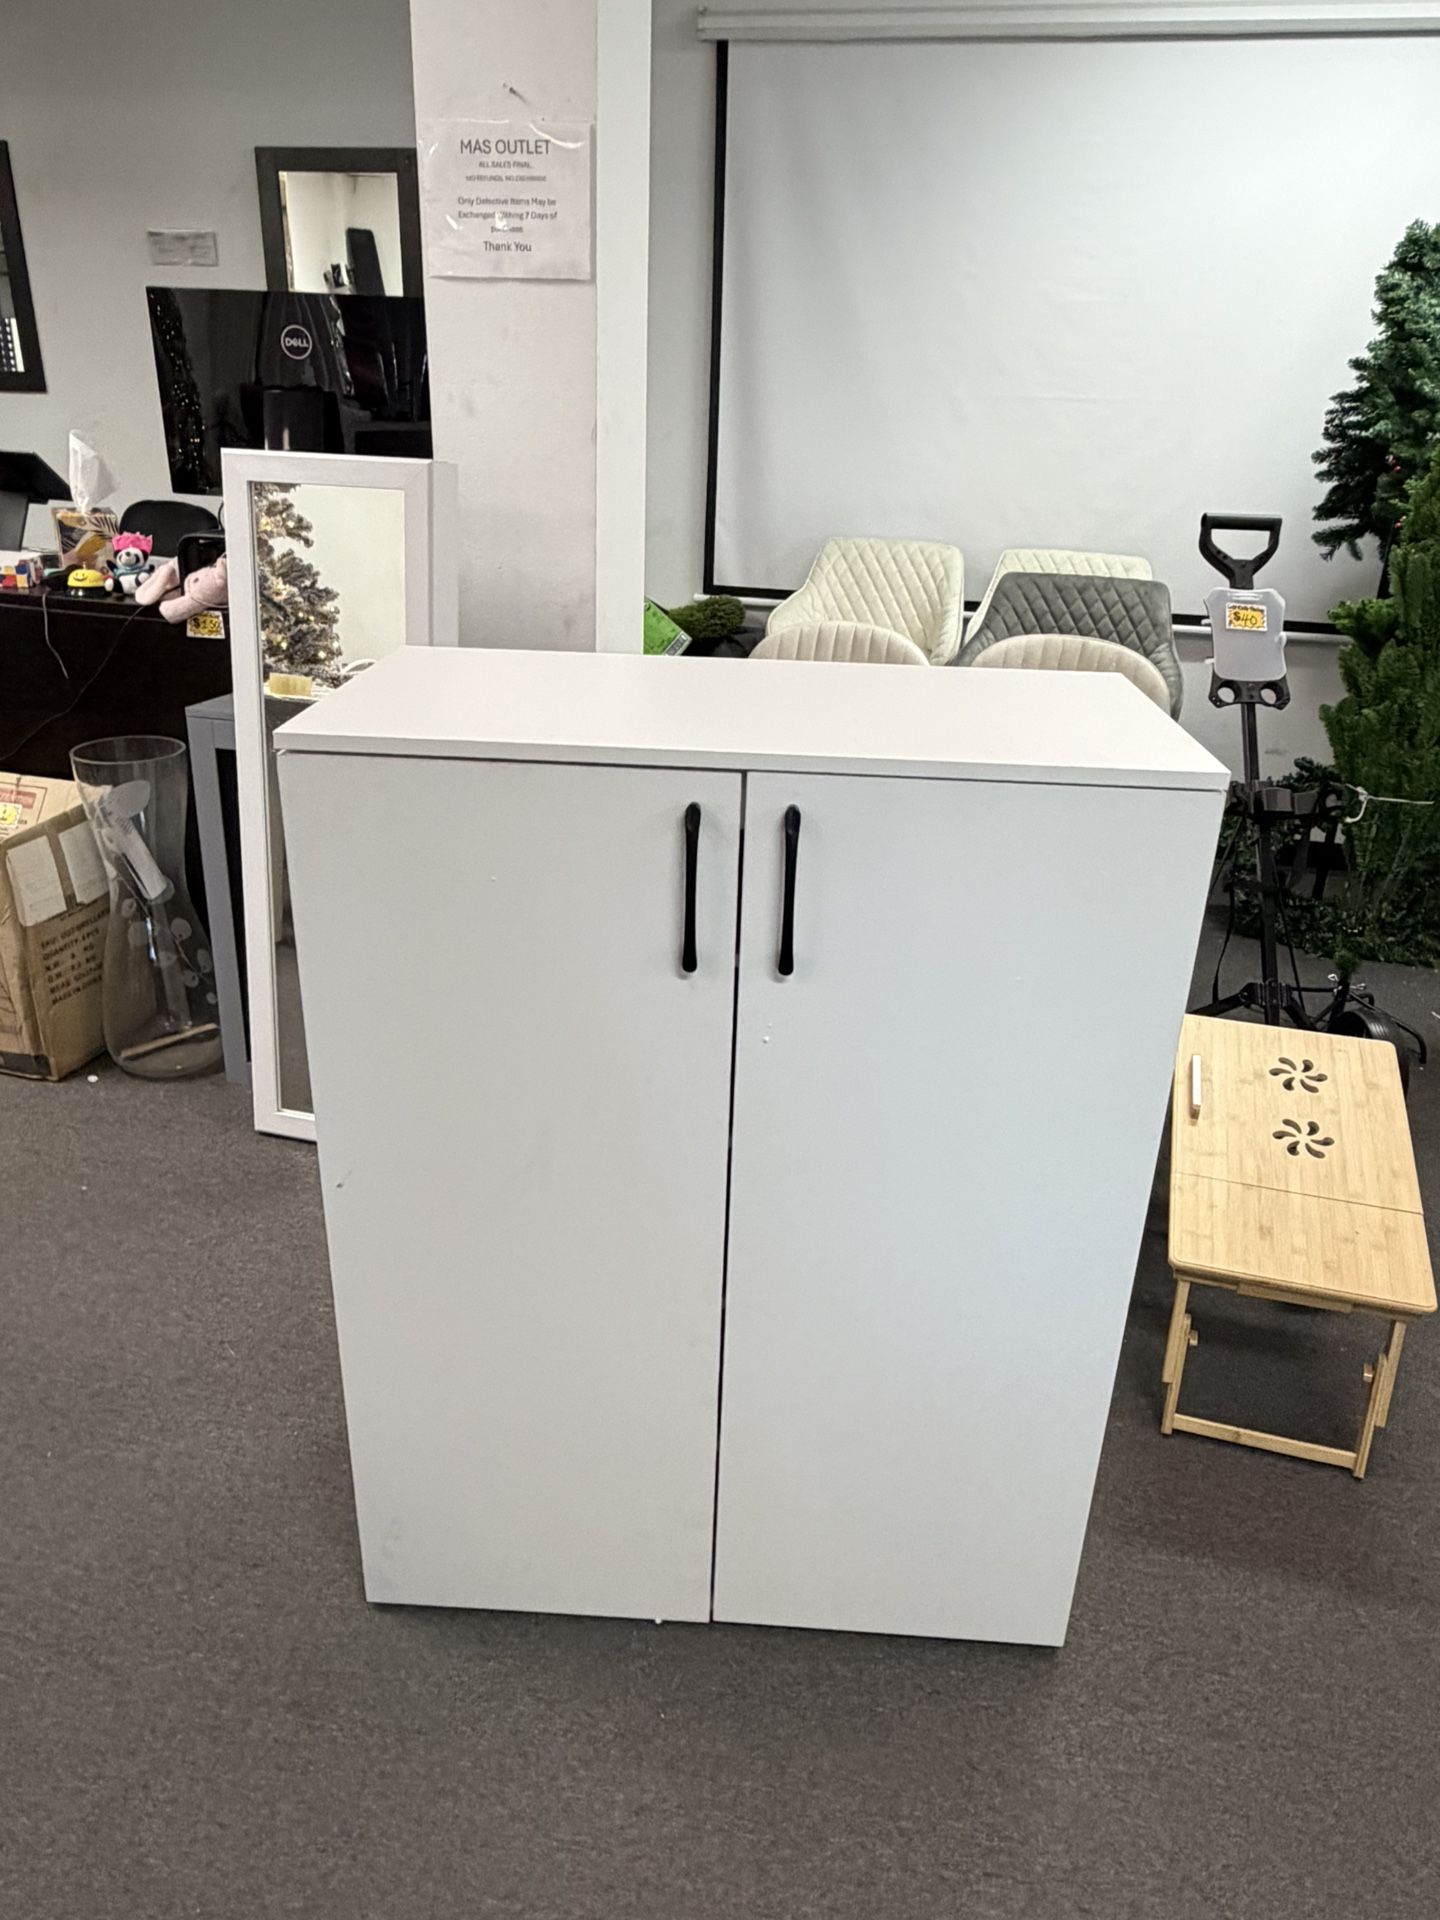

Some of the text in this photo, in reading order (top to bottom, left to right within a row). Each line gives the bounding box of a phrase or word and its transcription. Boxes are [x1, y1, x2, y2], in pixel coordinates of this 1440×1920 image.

[460, 139, 550, 155] MAS OUTLET
[457, 196, 474, 207] Only
[476, 197, 508, 206] Defective
[531, 197, 546, 207] May
[531, 211, 548, 220] Days
[483, 240, 532, 252] Thank You
[285, 337, 309, 348] DELL
[1233, 610, 1258, 627] $40
